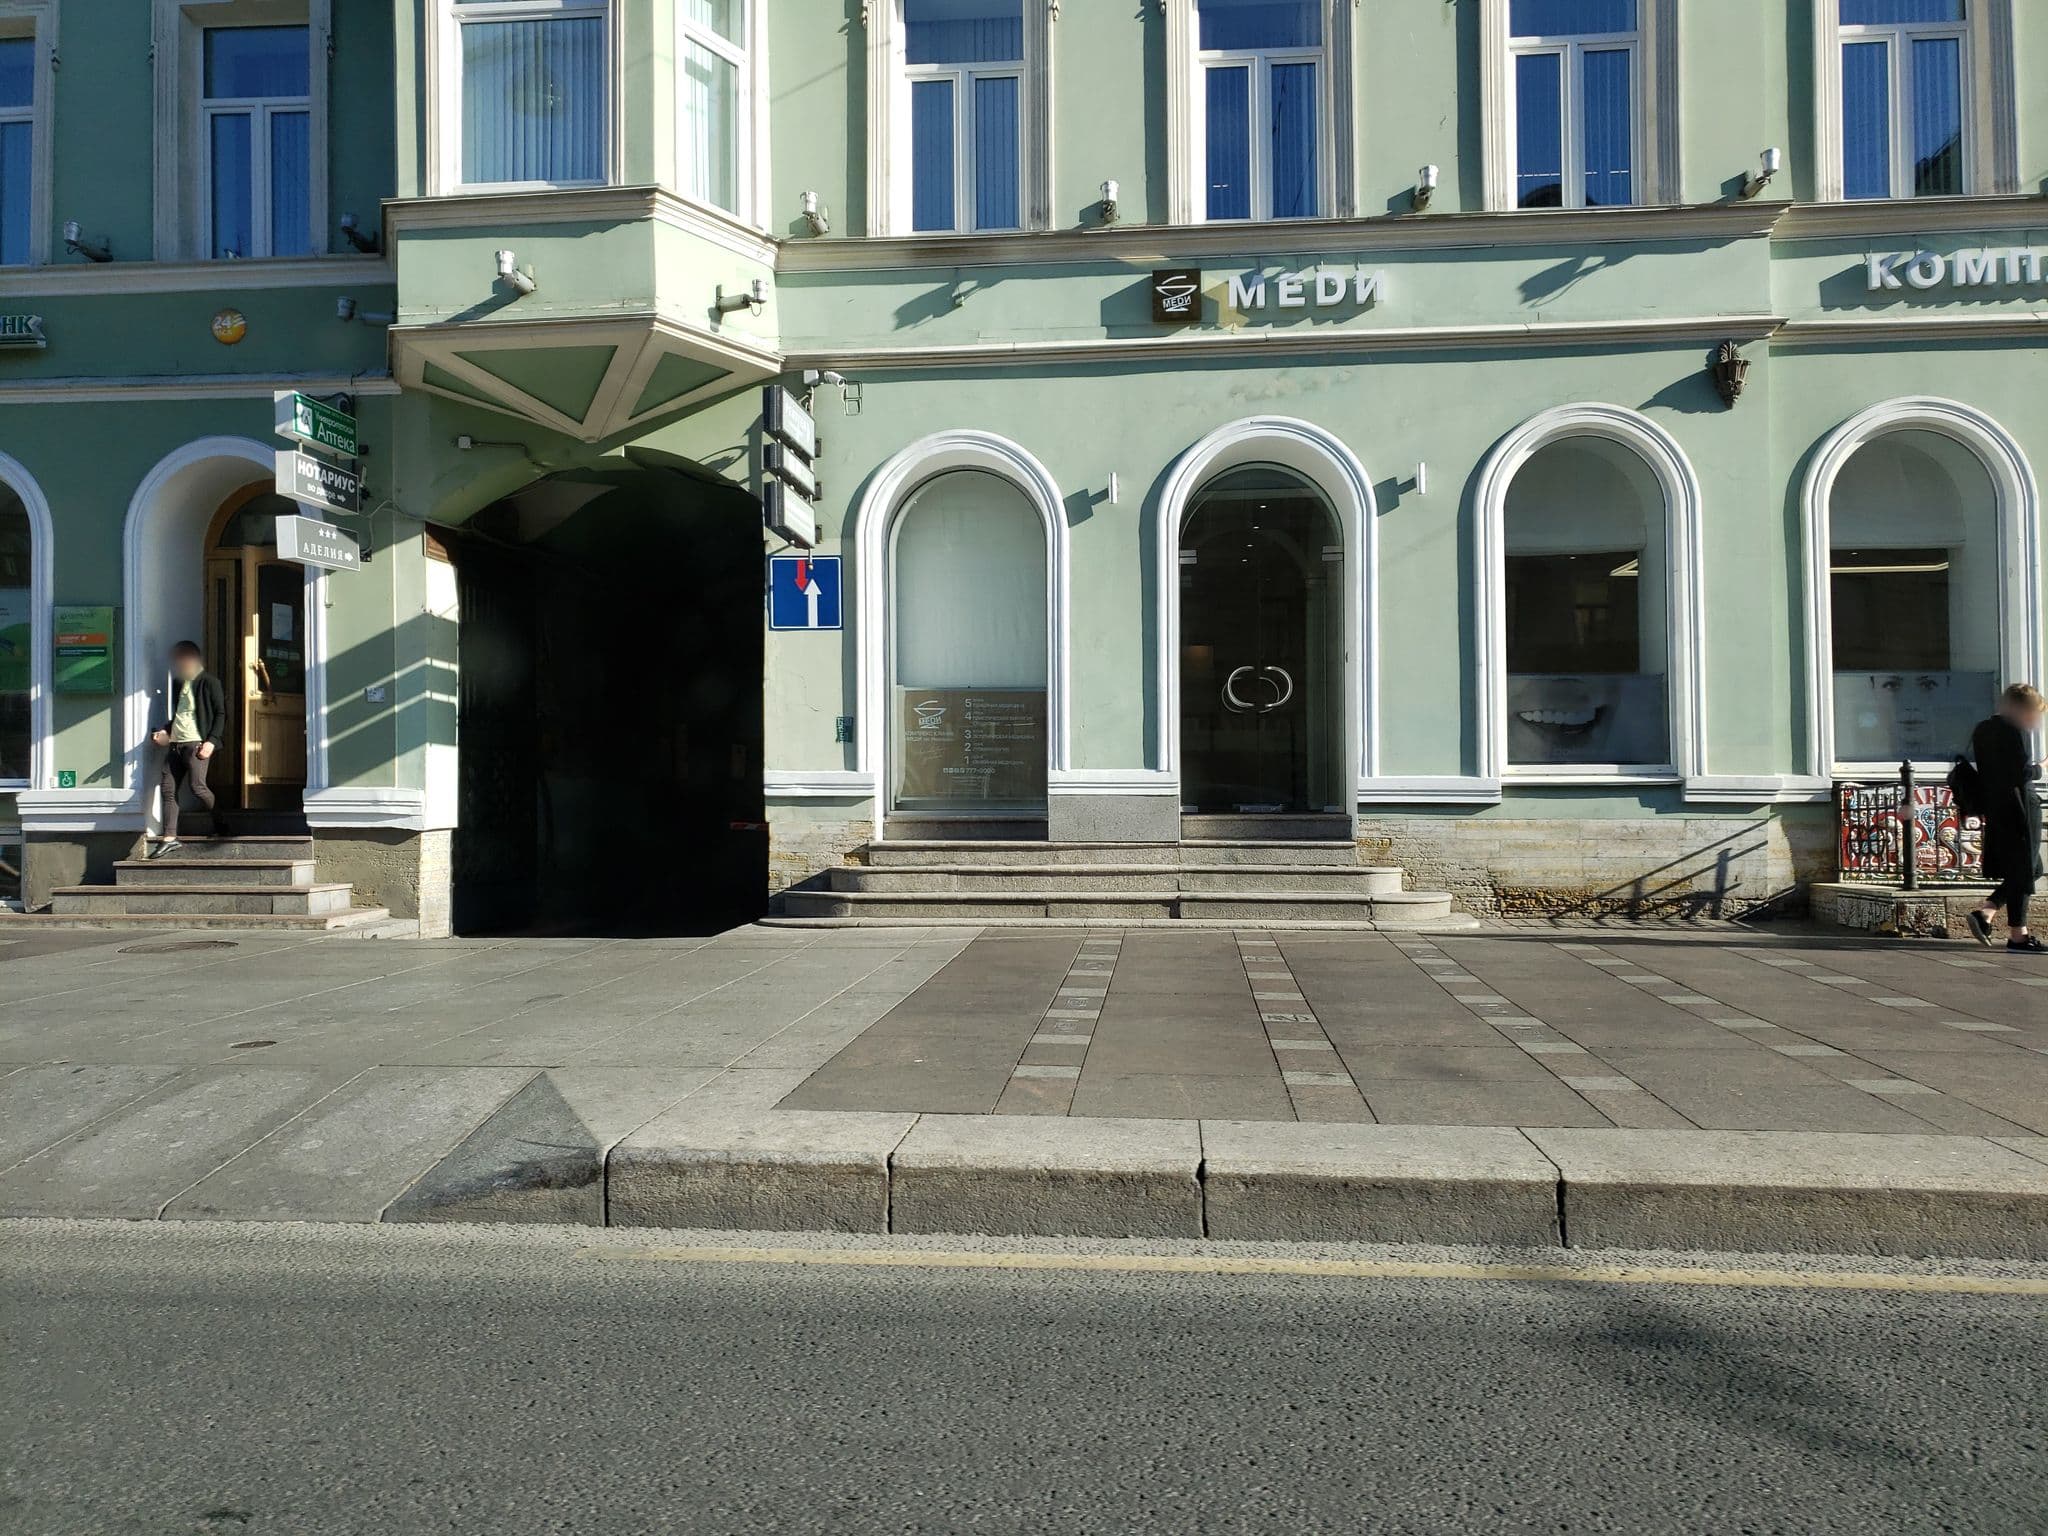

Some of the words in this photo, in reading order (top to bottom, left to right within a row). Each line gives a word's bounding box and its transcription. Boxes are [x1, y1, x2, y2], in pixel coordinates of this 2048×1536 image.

[1867, 248, 2048, 291] КОМП
[214, 315, 232, 329] 24
[317, 421, 355, 454] Аптека
[297, 459, 355, 494] НОТАРИУС
[303, 541, 343, 561] АДЕЛИЯ
[964, 698, 972, 708] 5
[964, 711, 972, 721] 4
[964, 729, 972, 739] 3
[964, 742, 972, 752] 2
[964, 755, 970, 765] 1
